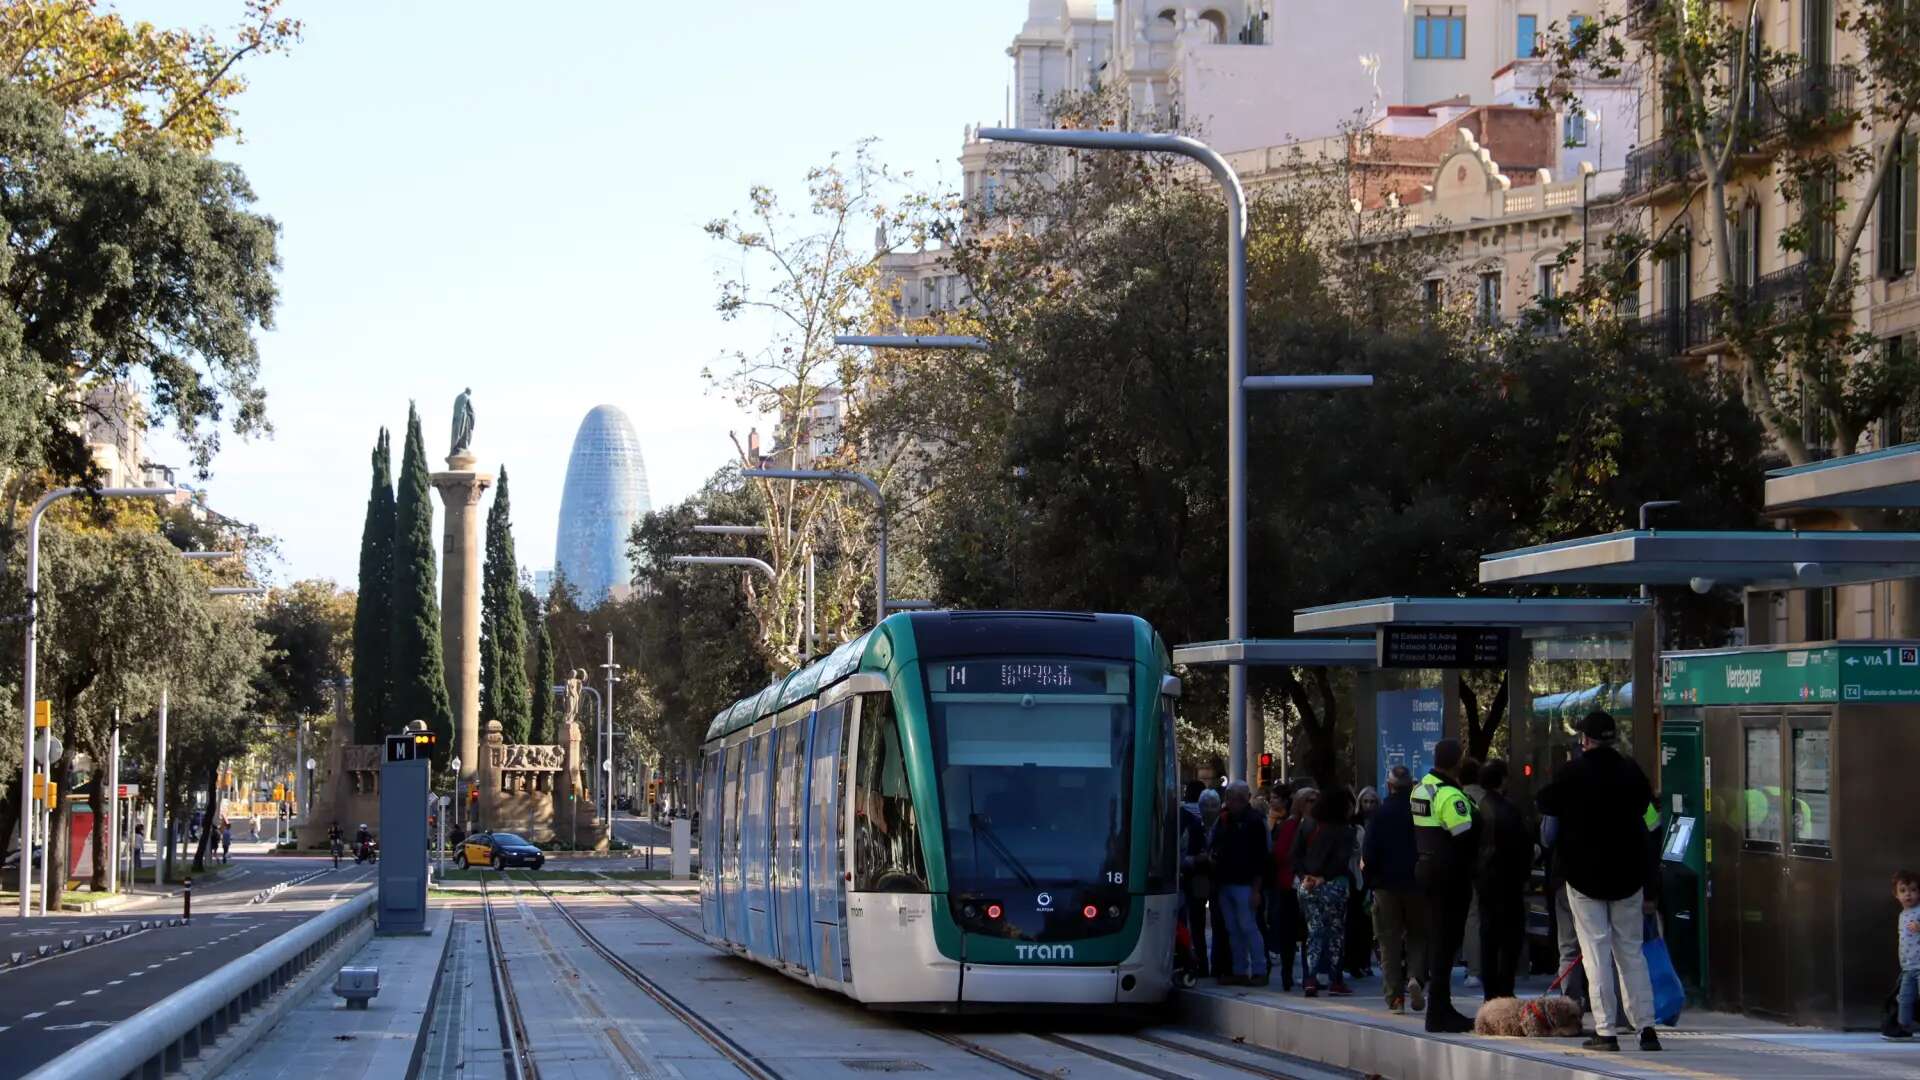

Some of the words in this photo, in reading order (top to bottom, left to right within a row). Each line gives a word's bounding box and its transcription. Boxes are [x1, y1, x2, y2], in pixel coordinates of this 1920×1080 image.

[1863, 655, 1883, 666] VIA
[1883, 647, 1892, 666] 1
[1726, 665, 1762, 693] Verdaguer
[396, 742, 406, 759] M
[1106, 871, 1123, 884] 18
